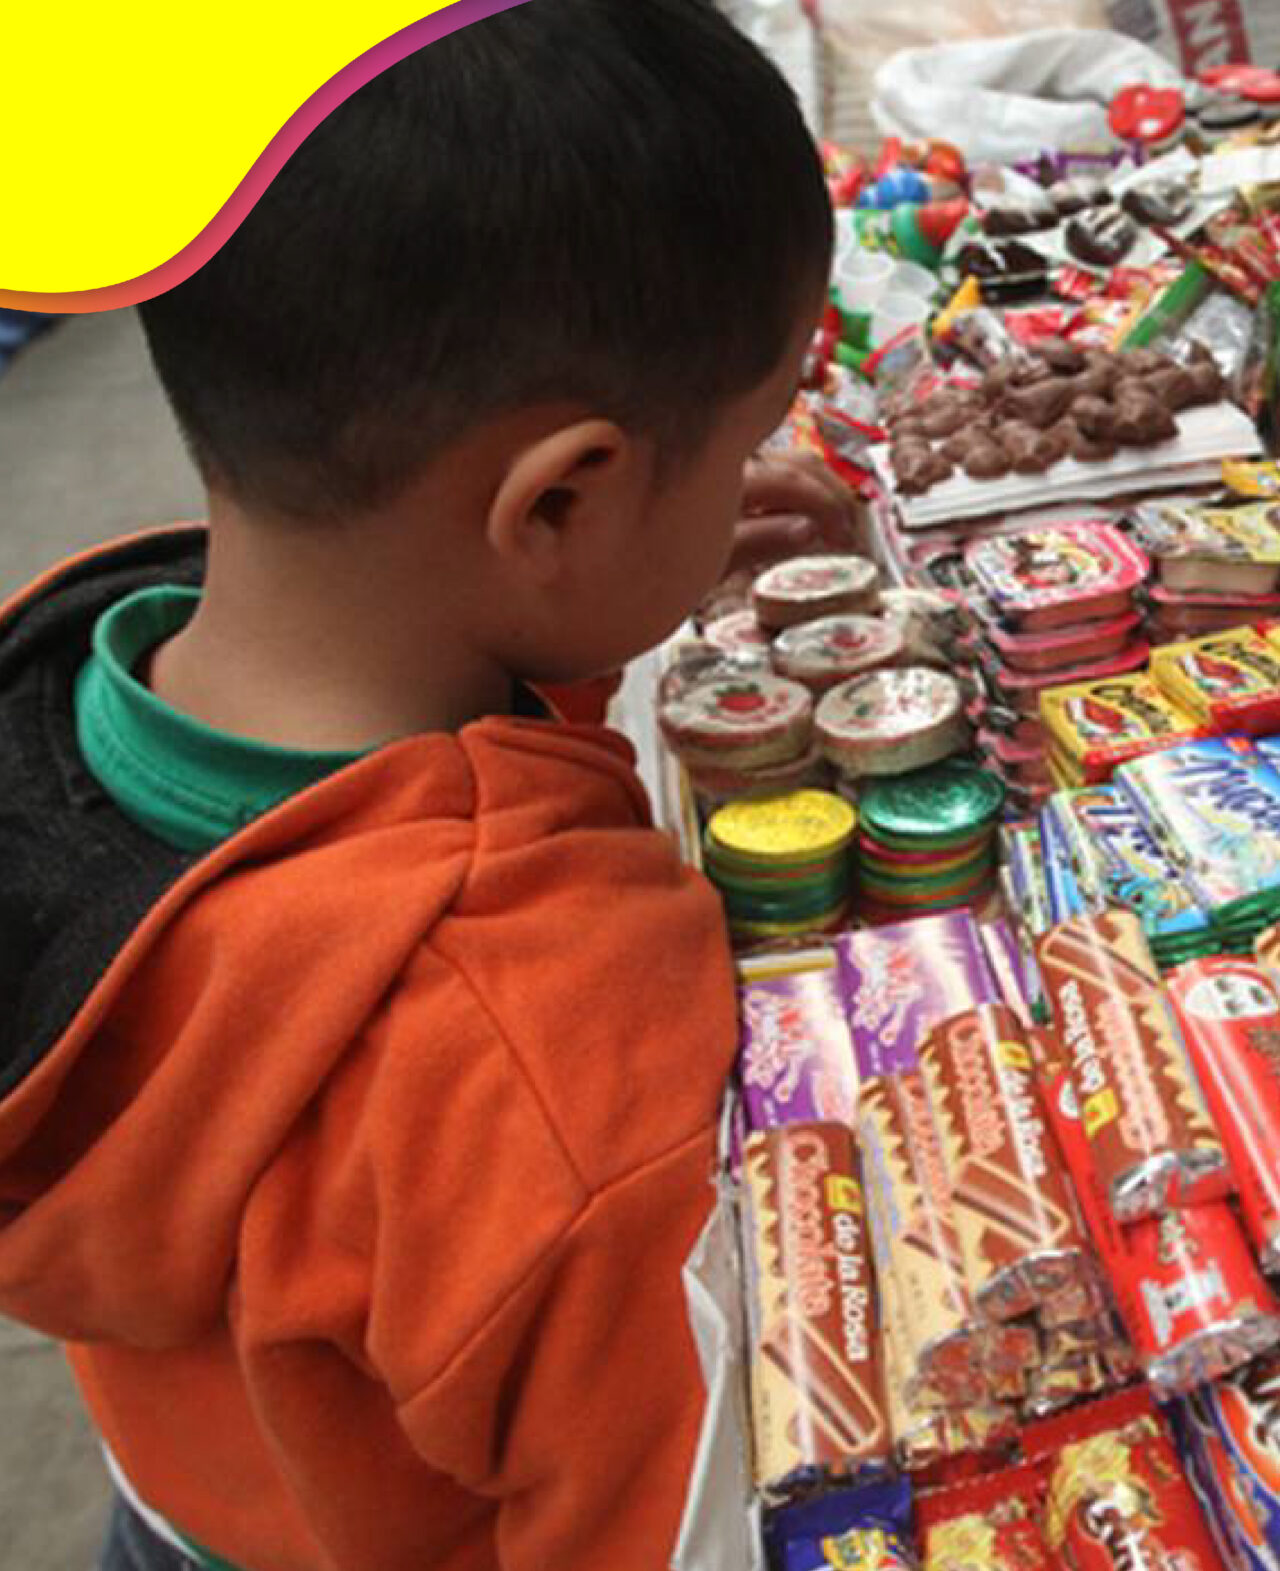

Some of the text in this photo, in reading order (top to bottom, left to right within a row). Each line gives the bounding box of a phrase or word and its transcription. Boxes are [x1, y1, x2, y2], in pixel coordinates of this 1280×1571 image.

[789, 1130, 833, 1317] Chocolate
[831, 1214, 870, 1364] de la Rosa
